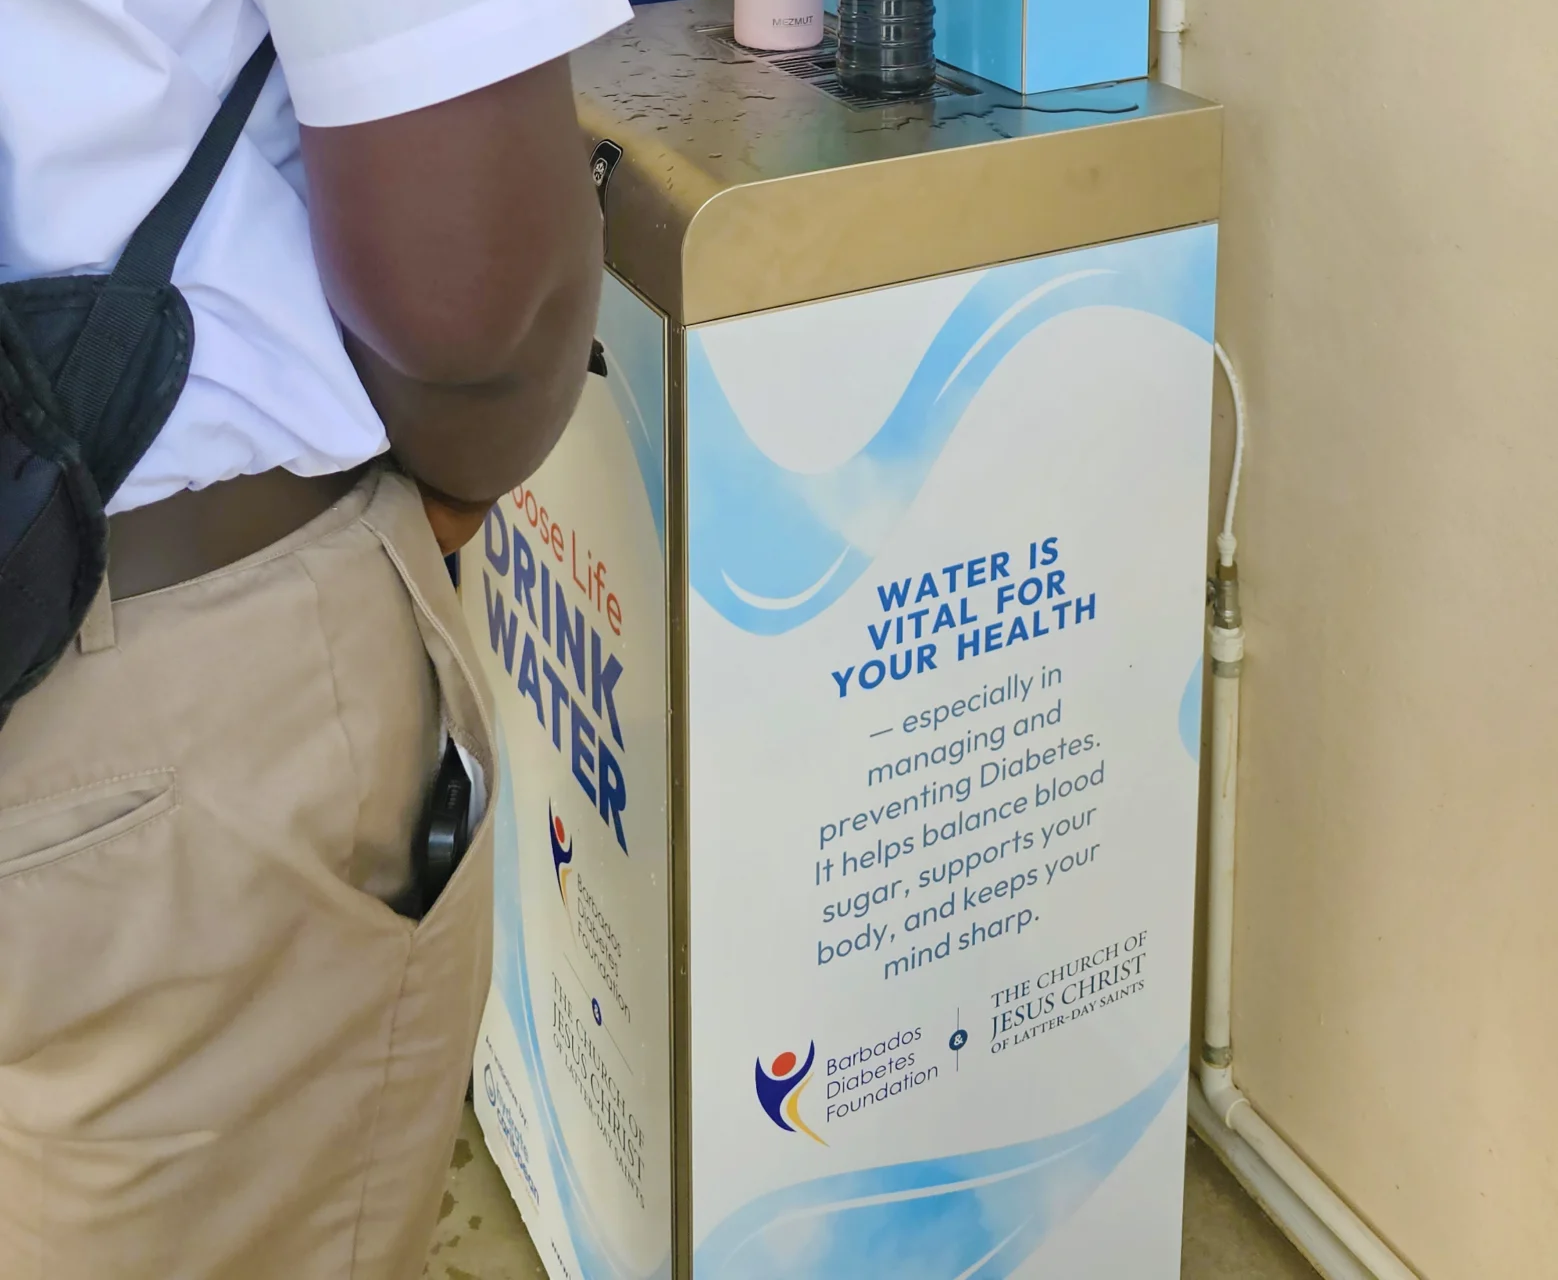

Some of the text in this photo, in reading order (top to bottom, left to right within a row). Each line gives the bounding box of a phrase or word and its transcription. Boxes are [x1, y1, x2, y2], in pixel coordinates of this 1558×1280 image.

[772, 16, 814, 26] MEZMUT
[572, 529, 622, 636] Life
[867, 570, 1066, 651] VITAL FOR
[877, 536, 1059, 612] WATER IS
[484, 502, 625, 753] DRINK
[831, 592, 1096, 698] YOUR HEALTH
[482, 567, 629, 858] WATER
[868, 699, 1062, 787] managing and
[902, 674, 1034, 734] especially
[1041, 666, 1062, 689] in
[816, 759, 1105, 886] It helps balance blood
[820, 732, 1101, 850] preventing Diabetes.
[817, 843, 1100, 966] body, and keeps your
[822, 807, 1097, 923] sugar, supports your
[577, 872, 622, 958] Barbados
[577, 897, 618, 978] Diabetes
[884, 908, 1040, 980] mind sharp.
[578, 921, 631, 1023] Foundation
[990, 952, 1146, 1043] JESUS CHRIST
[991, 930, 1148, 1008] THE CHURCH OF
[552, 972, 645, 1150] THE CHURCH OF
[826, 1027, 922, 1076] Barbados
[991, 980, 1145, 1054] OF LATTER-DAY SAINTS
[553, 1001, 645, 1180] JESUS CHRIST
[826, 1052, 915, 1100] Diabetes
[826, 1066, 938, 1122] Foundation
[553, 1032, 645, 1210] OF LATTER-DAY SAINTS
